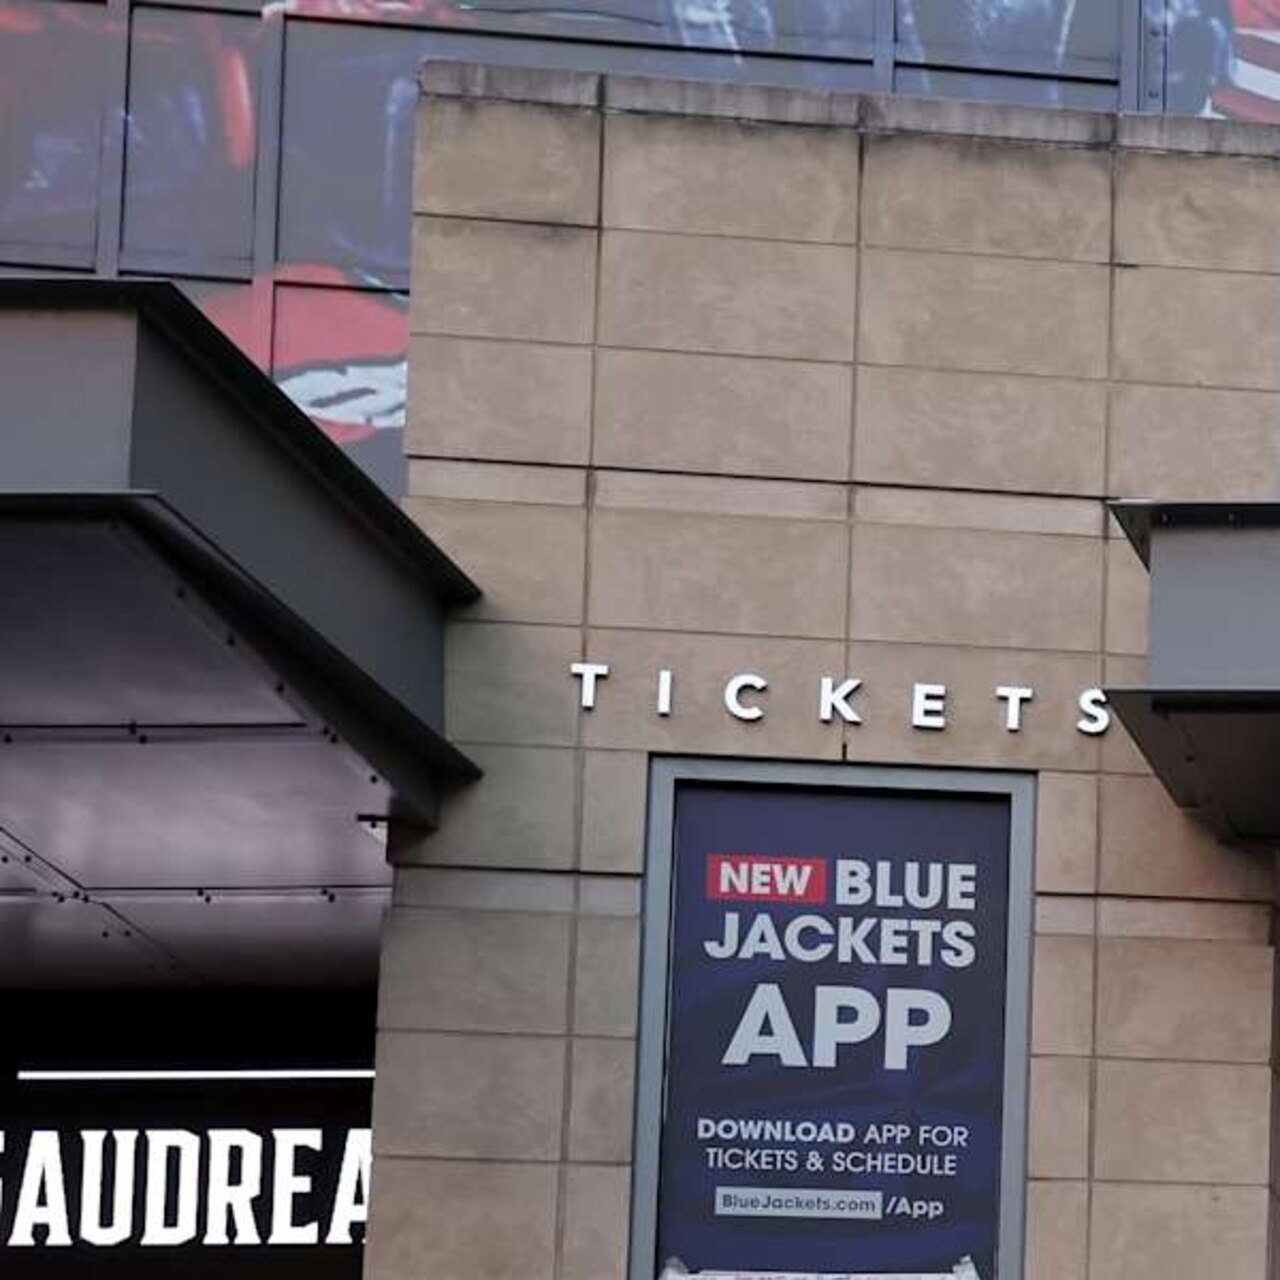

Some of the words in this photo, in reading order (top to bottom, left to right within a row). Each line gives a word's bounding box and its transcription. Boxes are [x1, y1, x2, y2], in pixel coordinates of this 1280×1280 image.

[569, 661, 1113, 735] TICKETS
[718, 863, 812, 898] NEW
[835, 859, 977, 911] BLUE
[703, 911, 977, 969] JACKETS
[721, 982, 953, 1072] APP
[696, 1118, 856, 1144] DOWNLOAD
[863, 1124, 911, 1147] APP
[918, 1125, 969, 1148] FOR
[0, 1128, 373, 1247] AUDREA
[705, 1148, 799, 1172] TICKETS
[806, 1150, 826, 1173] &
[831, 1151, 958, 1177] SCHEDULE
